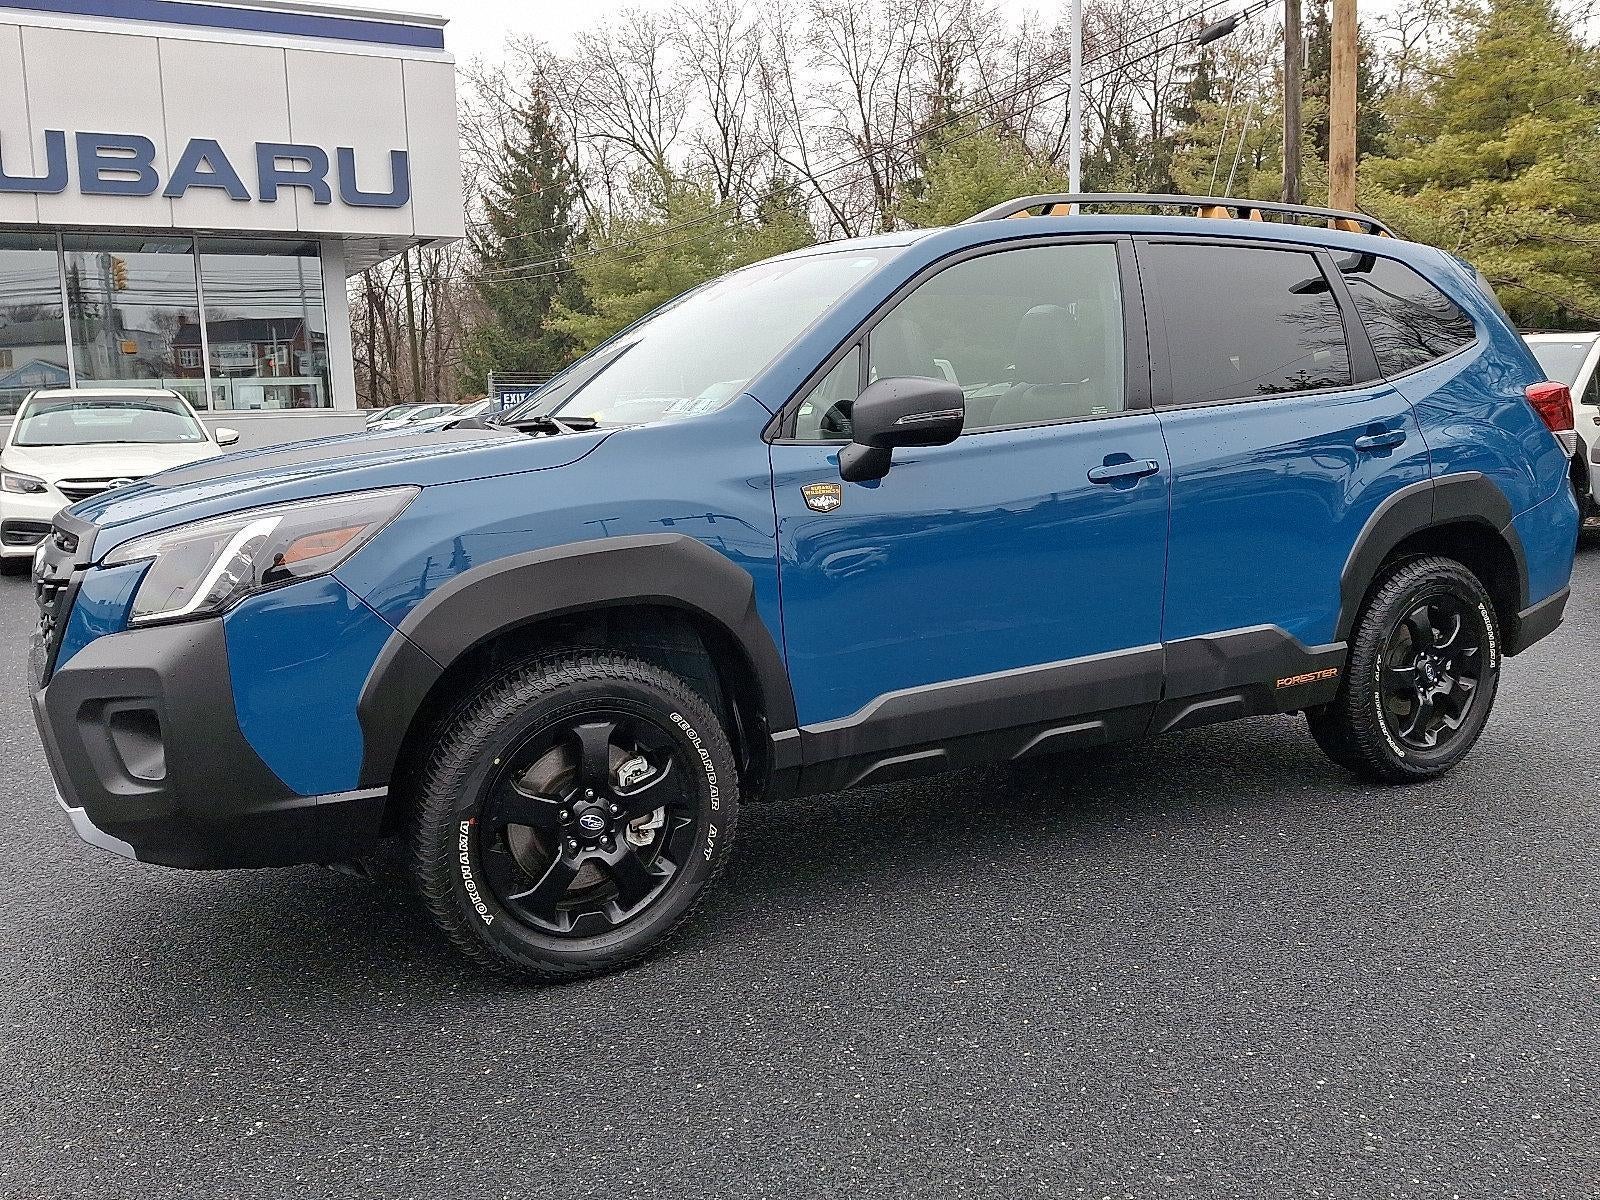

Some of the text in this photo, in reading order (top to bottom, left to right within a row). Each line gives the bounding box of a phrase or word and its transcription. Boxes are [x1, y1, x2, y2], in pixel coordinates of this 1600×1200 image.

[0, 129, 410, 208] UBARU
[503, 393, 526, 404] EXIT
[1276, 668, 1338, 689] FORESTER
[669, 711, 720, 811] GEOLANDAR
[459, 820, 495, 926] YOKOHAMA
